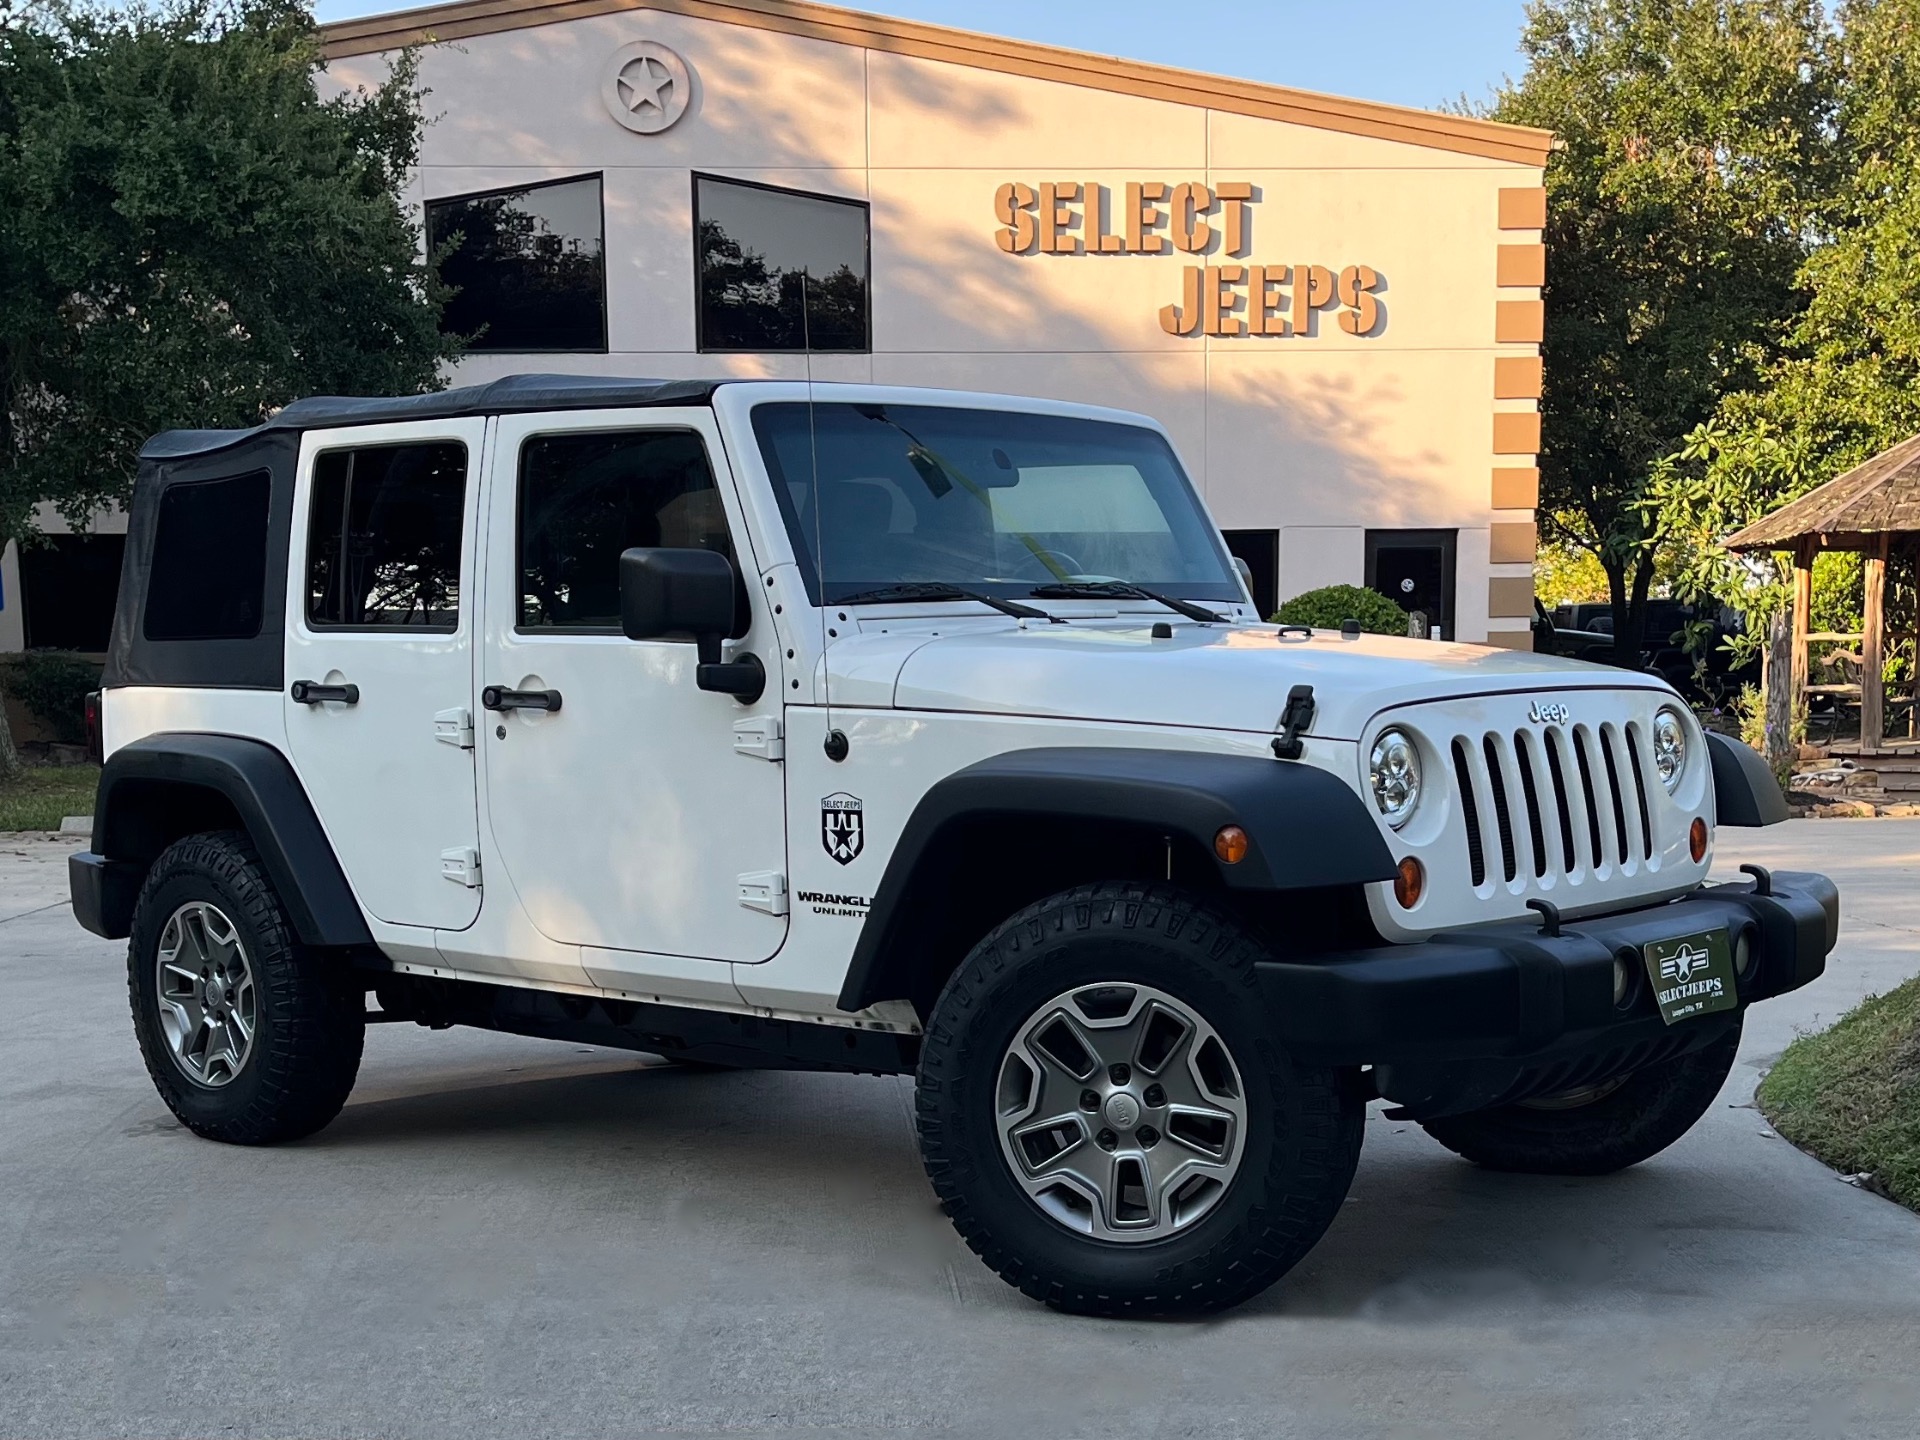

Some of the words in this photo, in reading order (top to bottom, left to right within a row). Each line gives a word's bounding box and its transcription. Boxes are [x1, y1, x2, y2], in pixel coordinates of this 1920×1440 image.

[994, 181, 1253, 256] SELECT
[1158, 265, 1380, 335] JEEPS
[1528, 699, 1570, 726] Jeep
